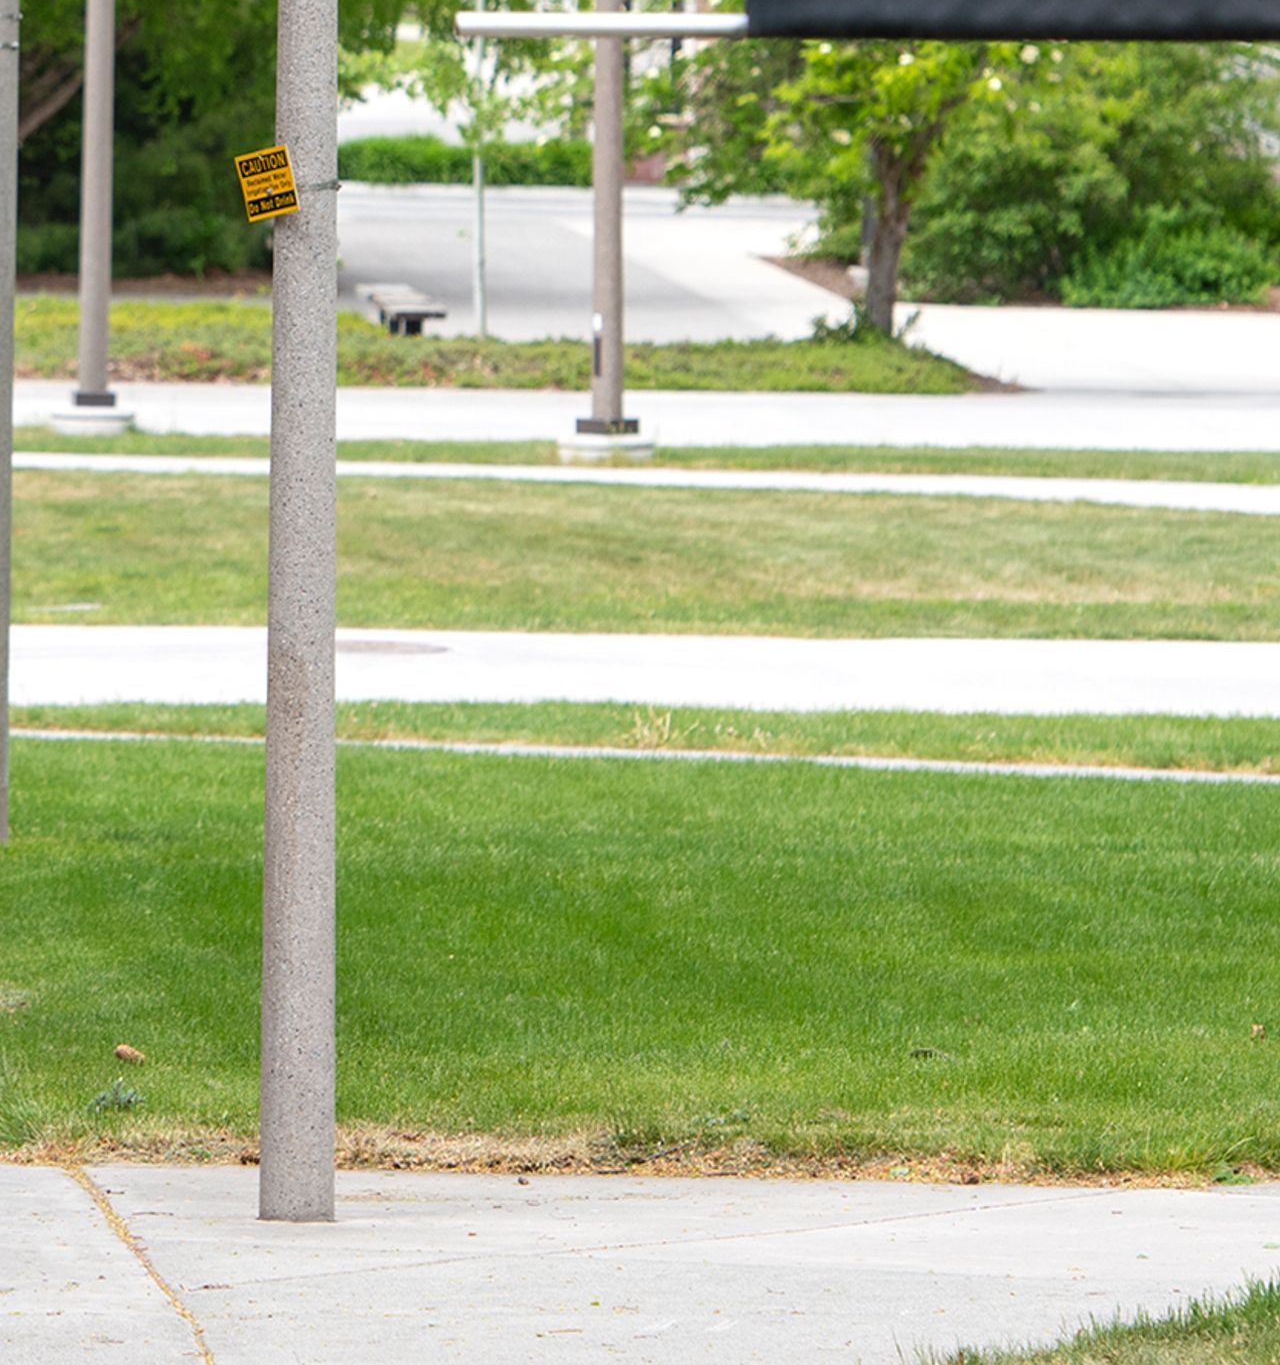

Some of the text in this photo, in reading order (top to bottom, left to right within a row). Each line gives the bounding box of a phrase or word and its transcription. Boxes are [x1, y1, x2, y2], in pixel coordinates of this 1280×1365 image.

[241, 152, 286, 176] CAUTION
[248, 192, 295, 215] Do Not Drink
